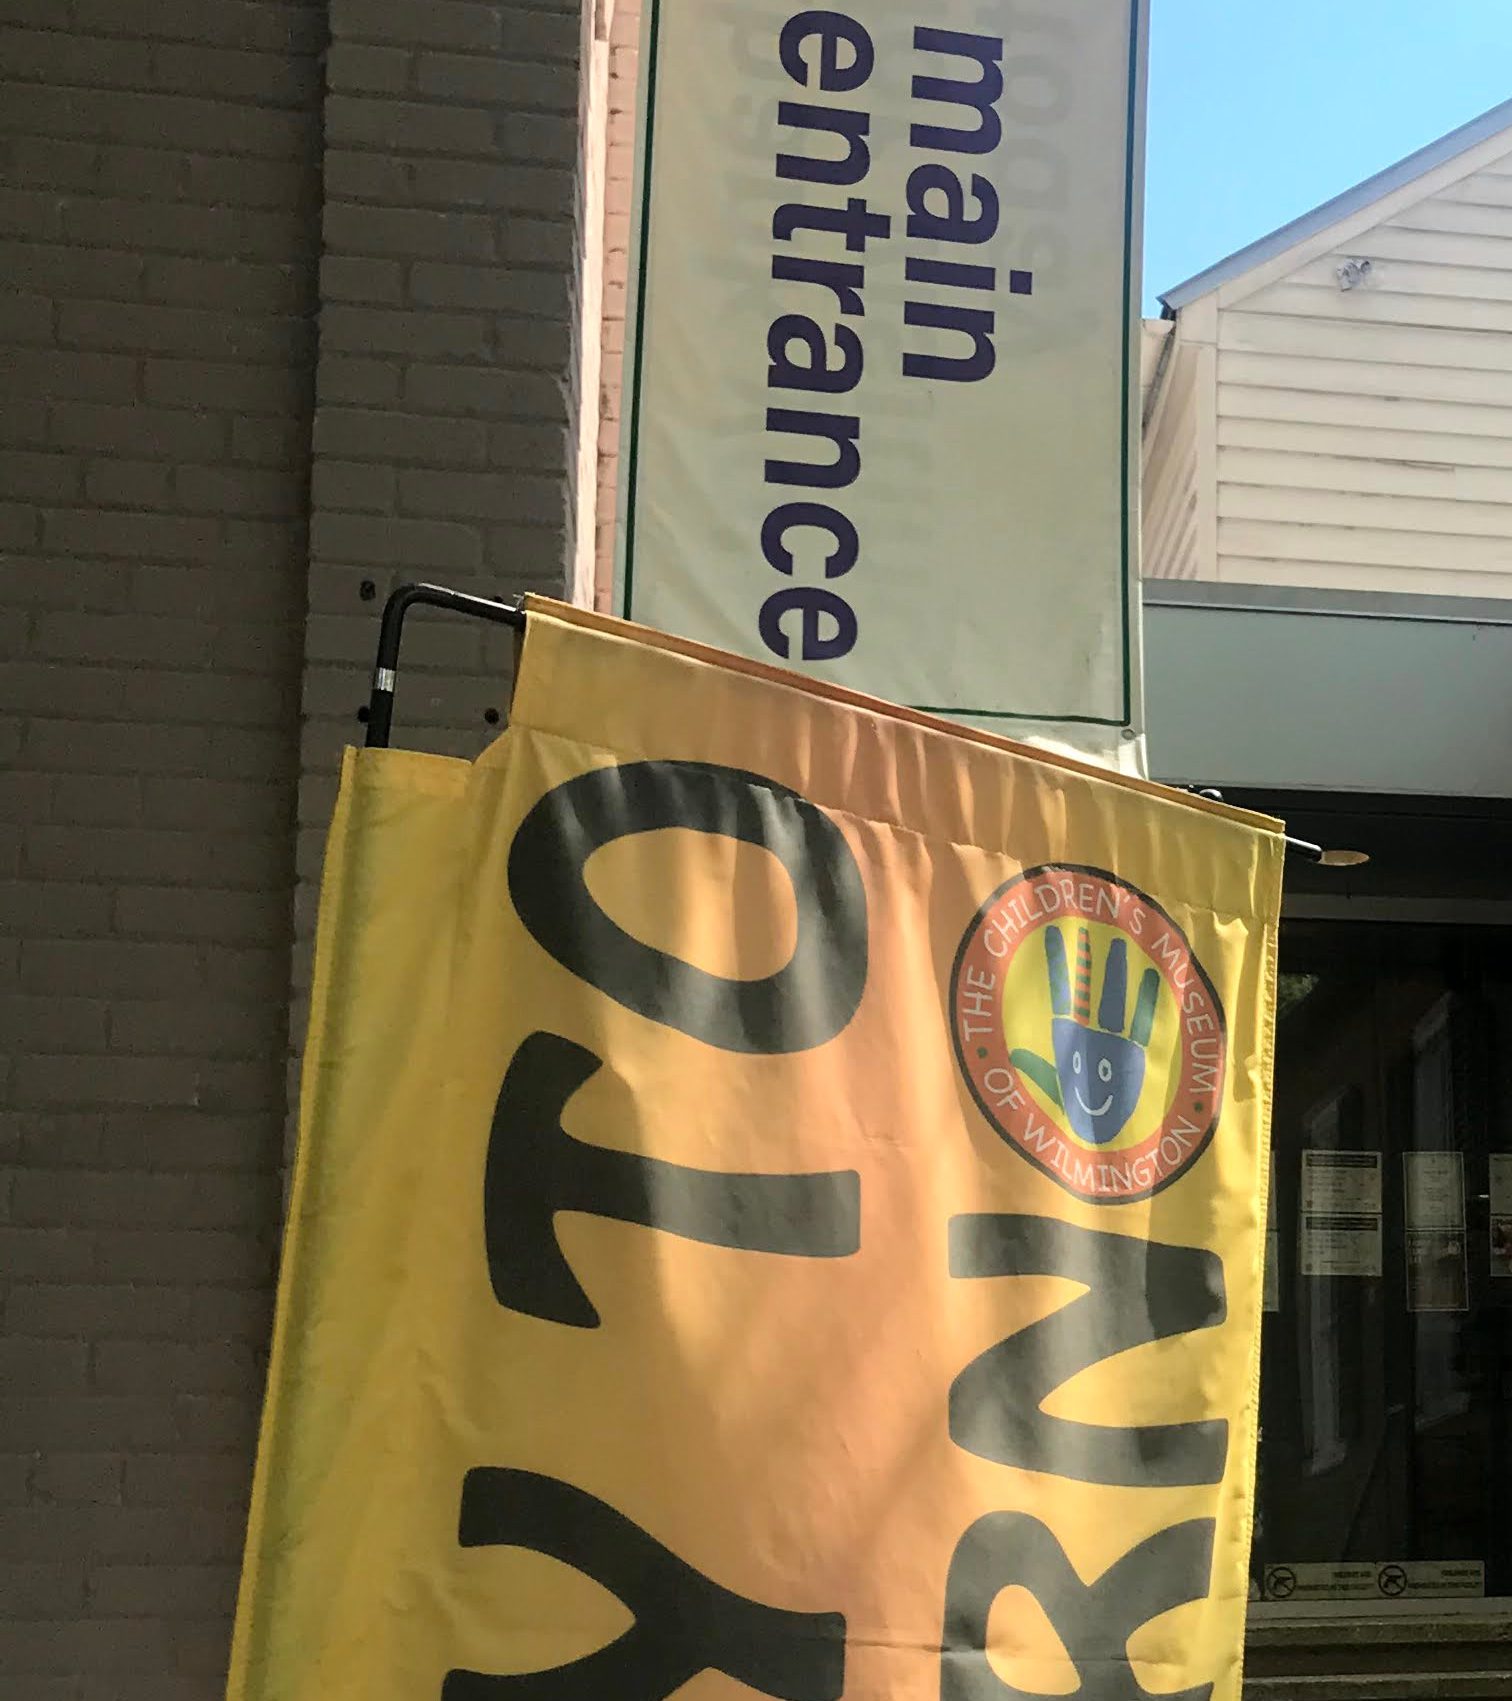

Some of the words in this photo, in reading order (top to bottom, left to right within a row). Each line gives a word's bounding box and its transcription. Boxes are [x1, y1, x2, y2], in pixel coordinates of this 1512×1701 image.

[758, 8, 891, 661] entrance
[902, 25, 1033, 383] main
[482, 760, 868, 1328] TO
[962, 965, 996, 1043] THE
[983, 879, 1146, 960] CHILDREN'S
[1151, 931, 1218, 1094] MUSEUM
[983, 1066, 1027, 1113] OF
[1023, 1113, 1202, 1194] WILMINGTON
